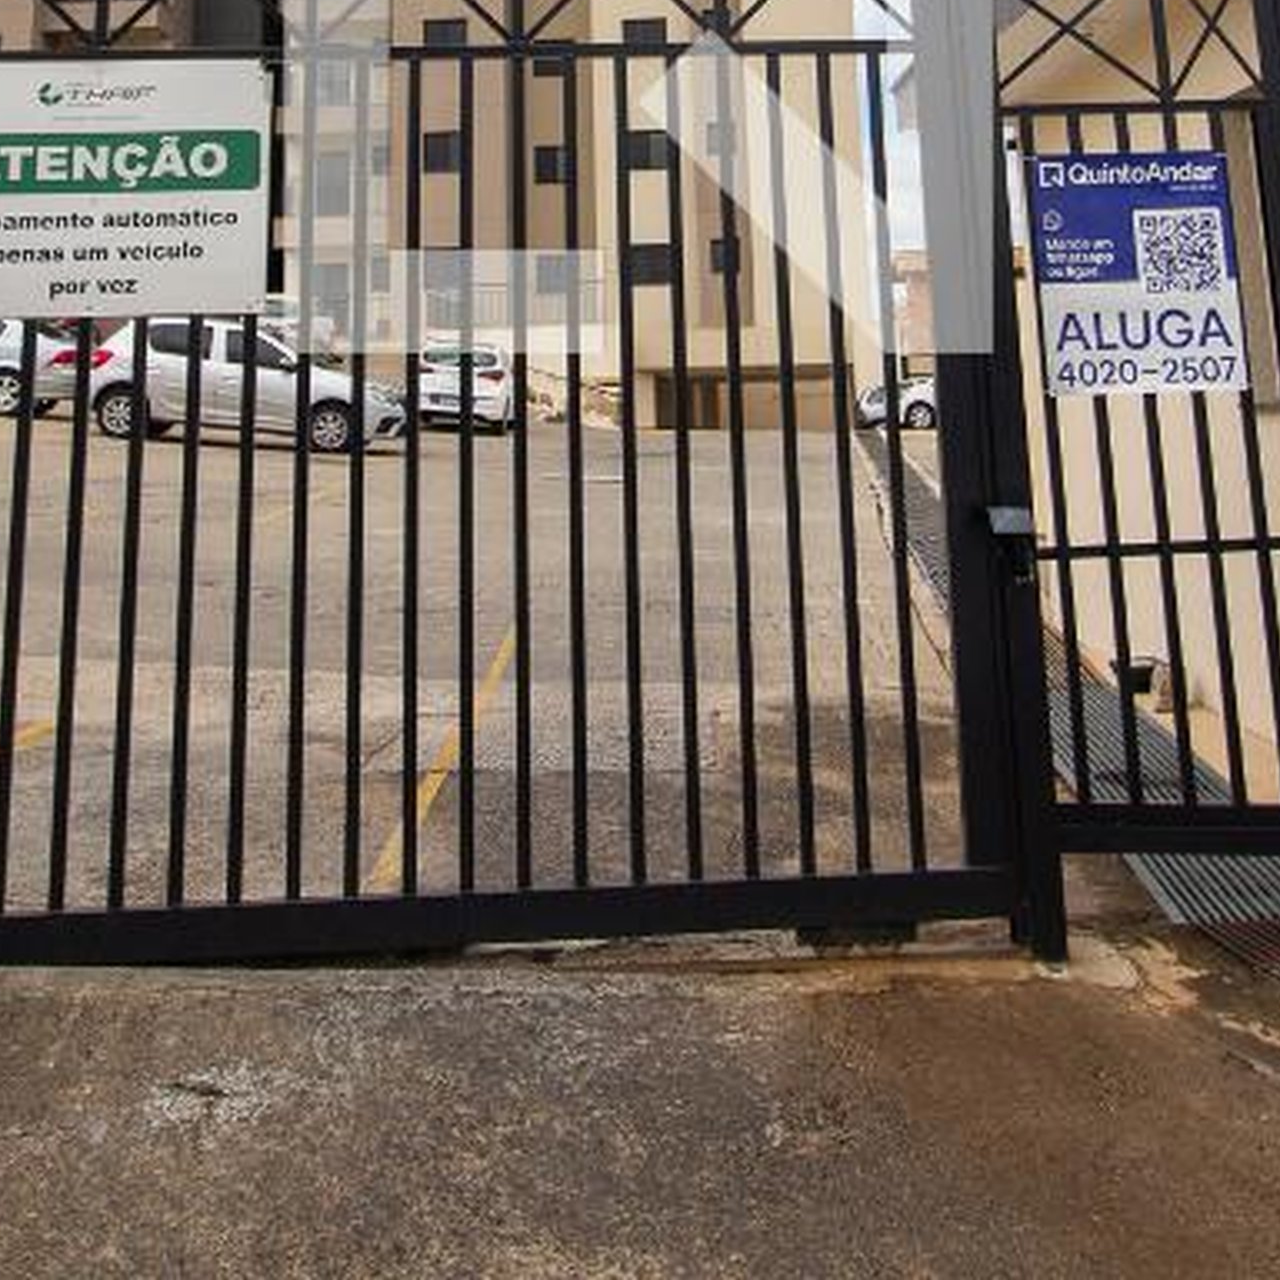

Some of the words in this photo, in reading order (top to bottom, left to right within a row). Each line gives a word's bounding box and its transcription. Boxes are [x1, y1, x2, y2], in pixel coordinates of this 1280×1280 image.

[1068, 162, 1217, 185] QuintoAndar
[72, 247, 108, 262] um
[49, 280, 89, 299] por
[97, 278, 138, 294] vez
[1057, 309, 1233, 351] ALUGA
[1057, 357, 1237, 387] 4020-2507
